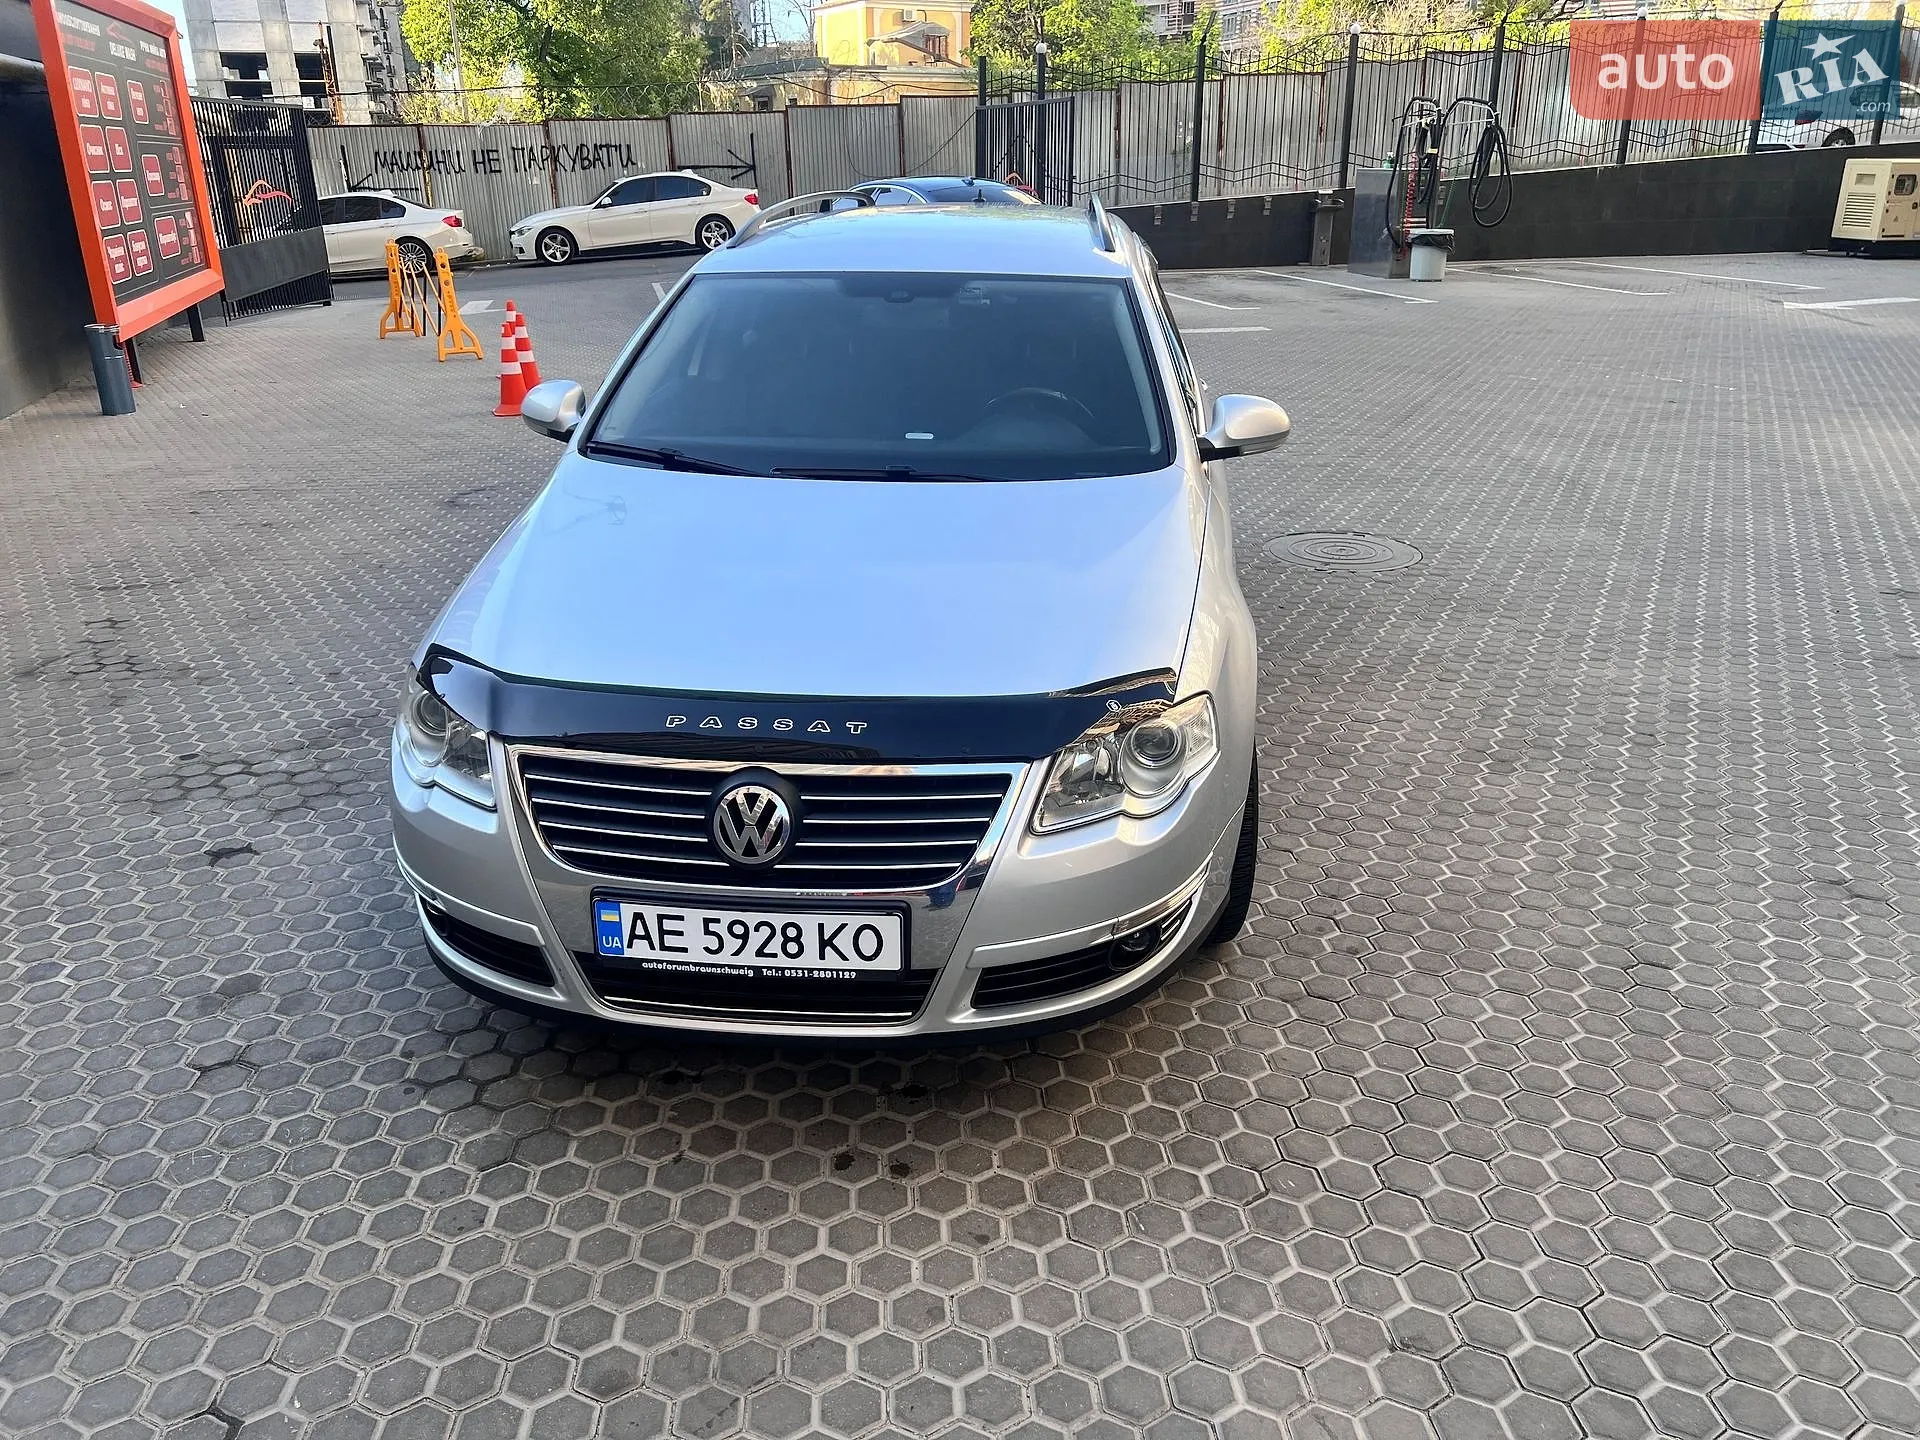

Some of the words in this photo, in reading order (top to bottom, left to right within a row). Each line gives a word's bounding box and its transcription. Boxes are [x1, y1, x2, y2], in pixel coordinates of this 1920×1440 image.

[374, 149, 466, 175] МАШИНИ
[472, 149, 502, 174] НЕ
[511, 143, 637, 173] ПАРКУВАТИ
[665, 715, 868, 734] PASSAT
[602, 936, 622, 949] UA
[626, 911, 689, 954] AE
[701, 917, 805, 960] 5928
[817, 922, 884, 962] KO
[641, 961, 754, 977] autoforumbraunschweig
